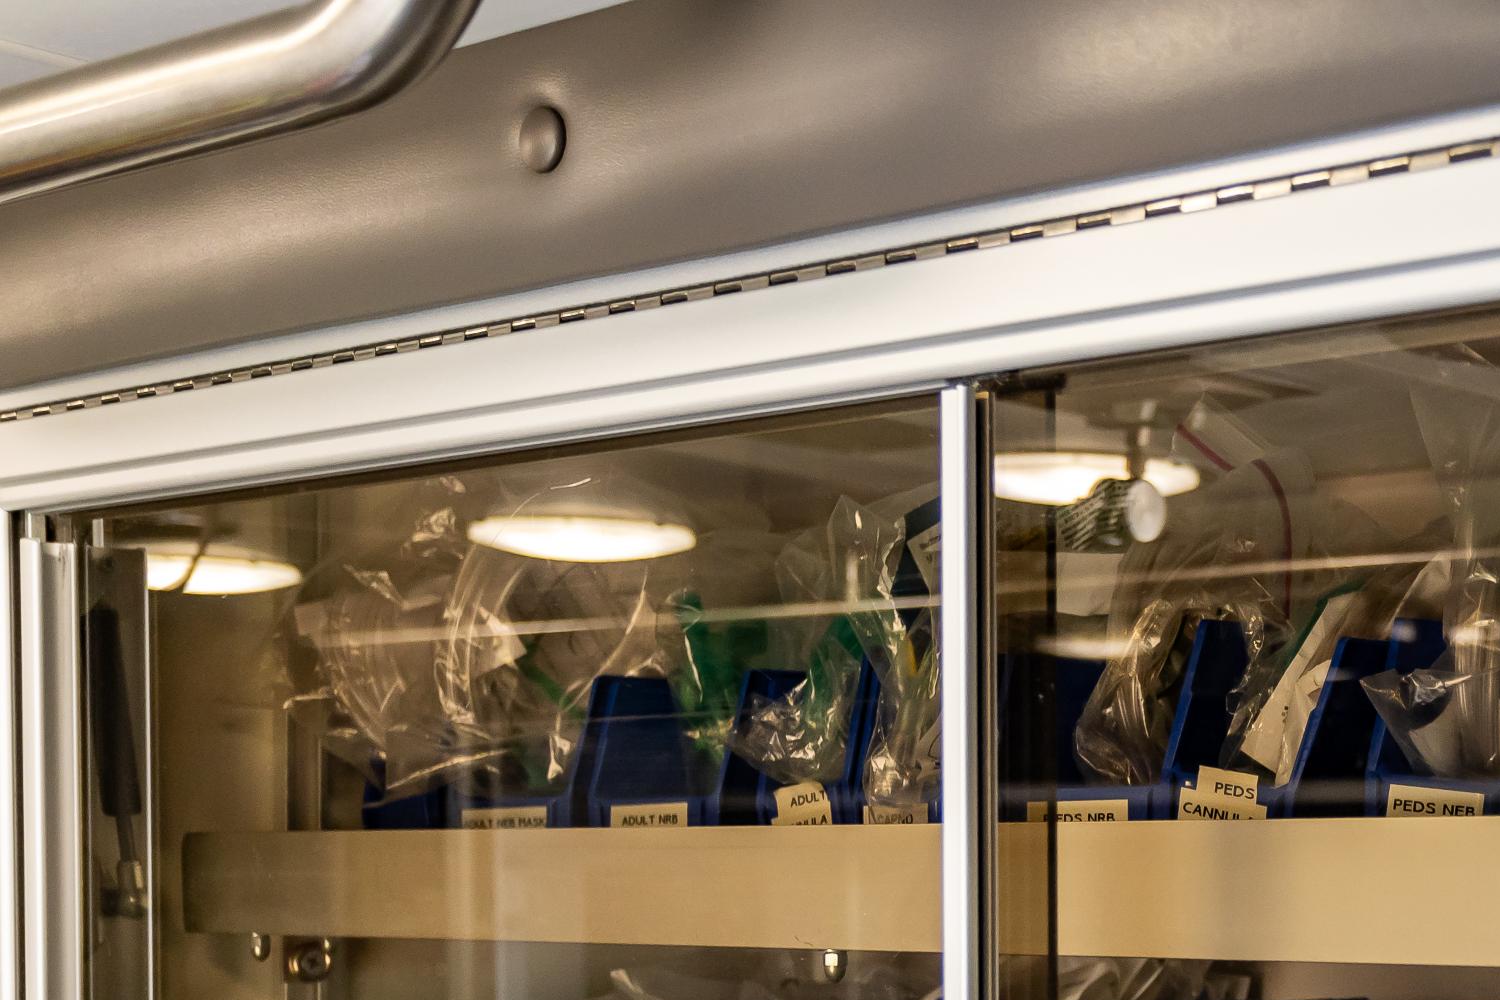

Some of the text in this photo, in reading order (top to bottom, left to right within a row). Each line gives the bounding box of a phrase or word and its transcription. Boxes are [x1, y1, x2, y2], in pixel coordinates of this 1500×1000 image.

[790, 790, 826, 807] ADULT
[1214, 781, 1255, 800] PEDS
[1393, 798, 1436, 814] PEDS
[622, 814, 678, 826] ADULT NRB
[1088, 812, 1116, 822] NRB
